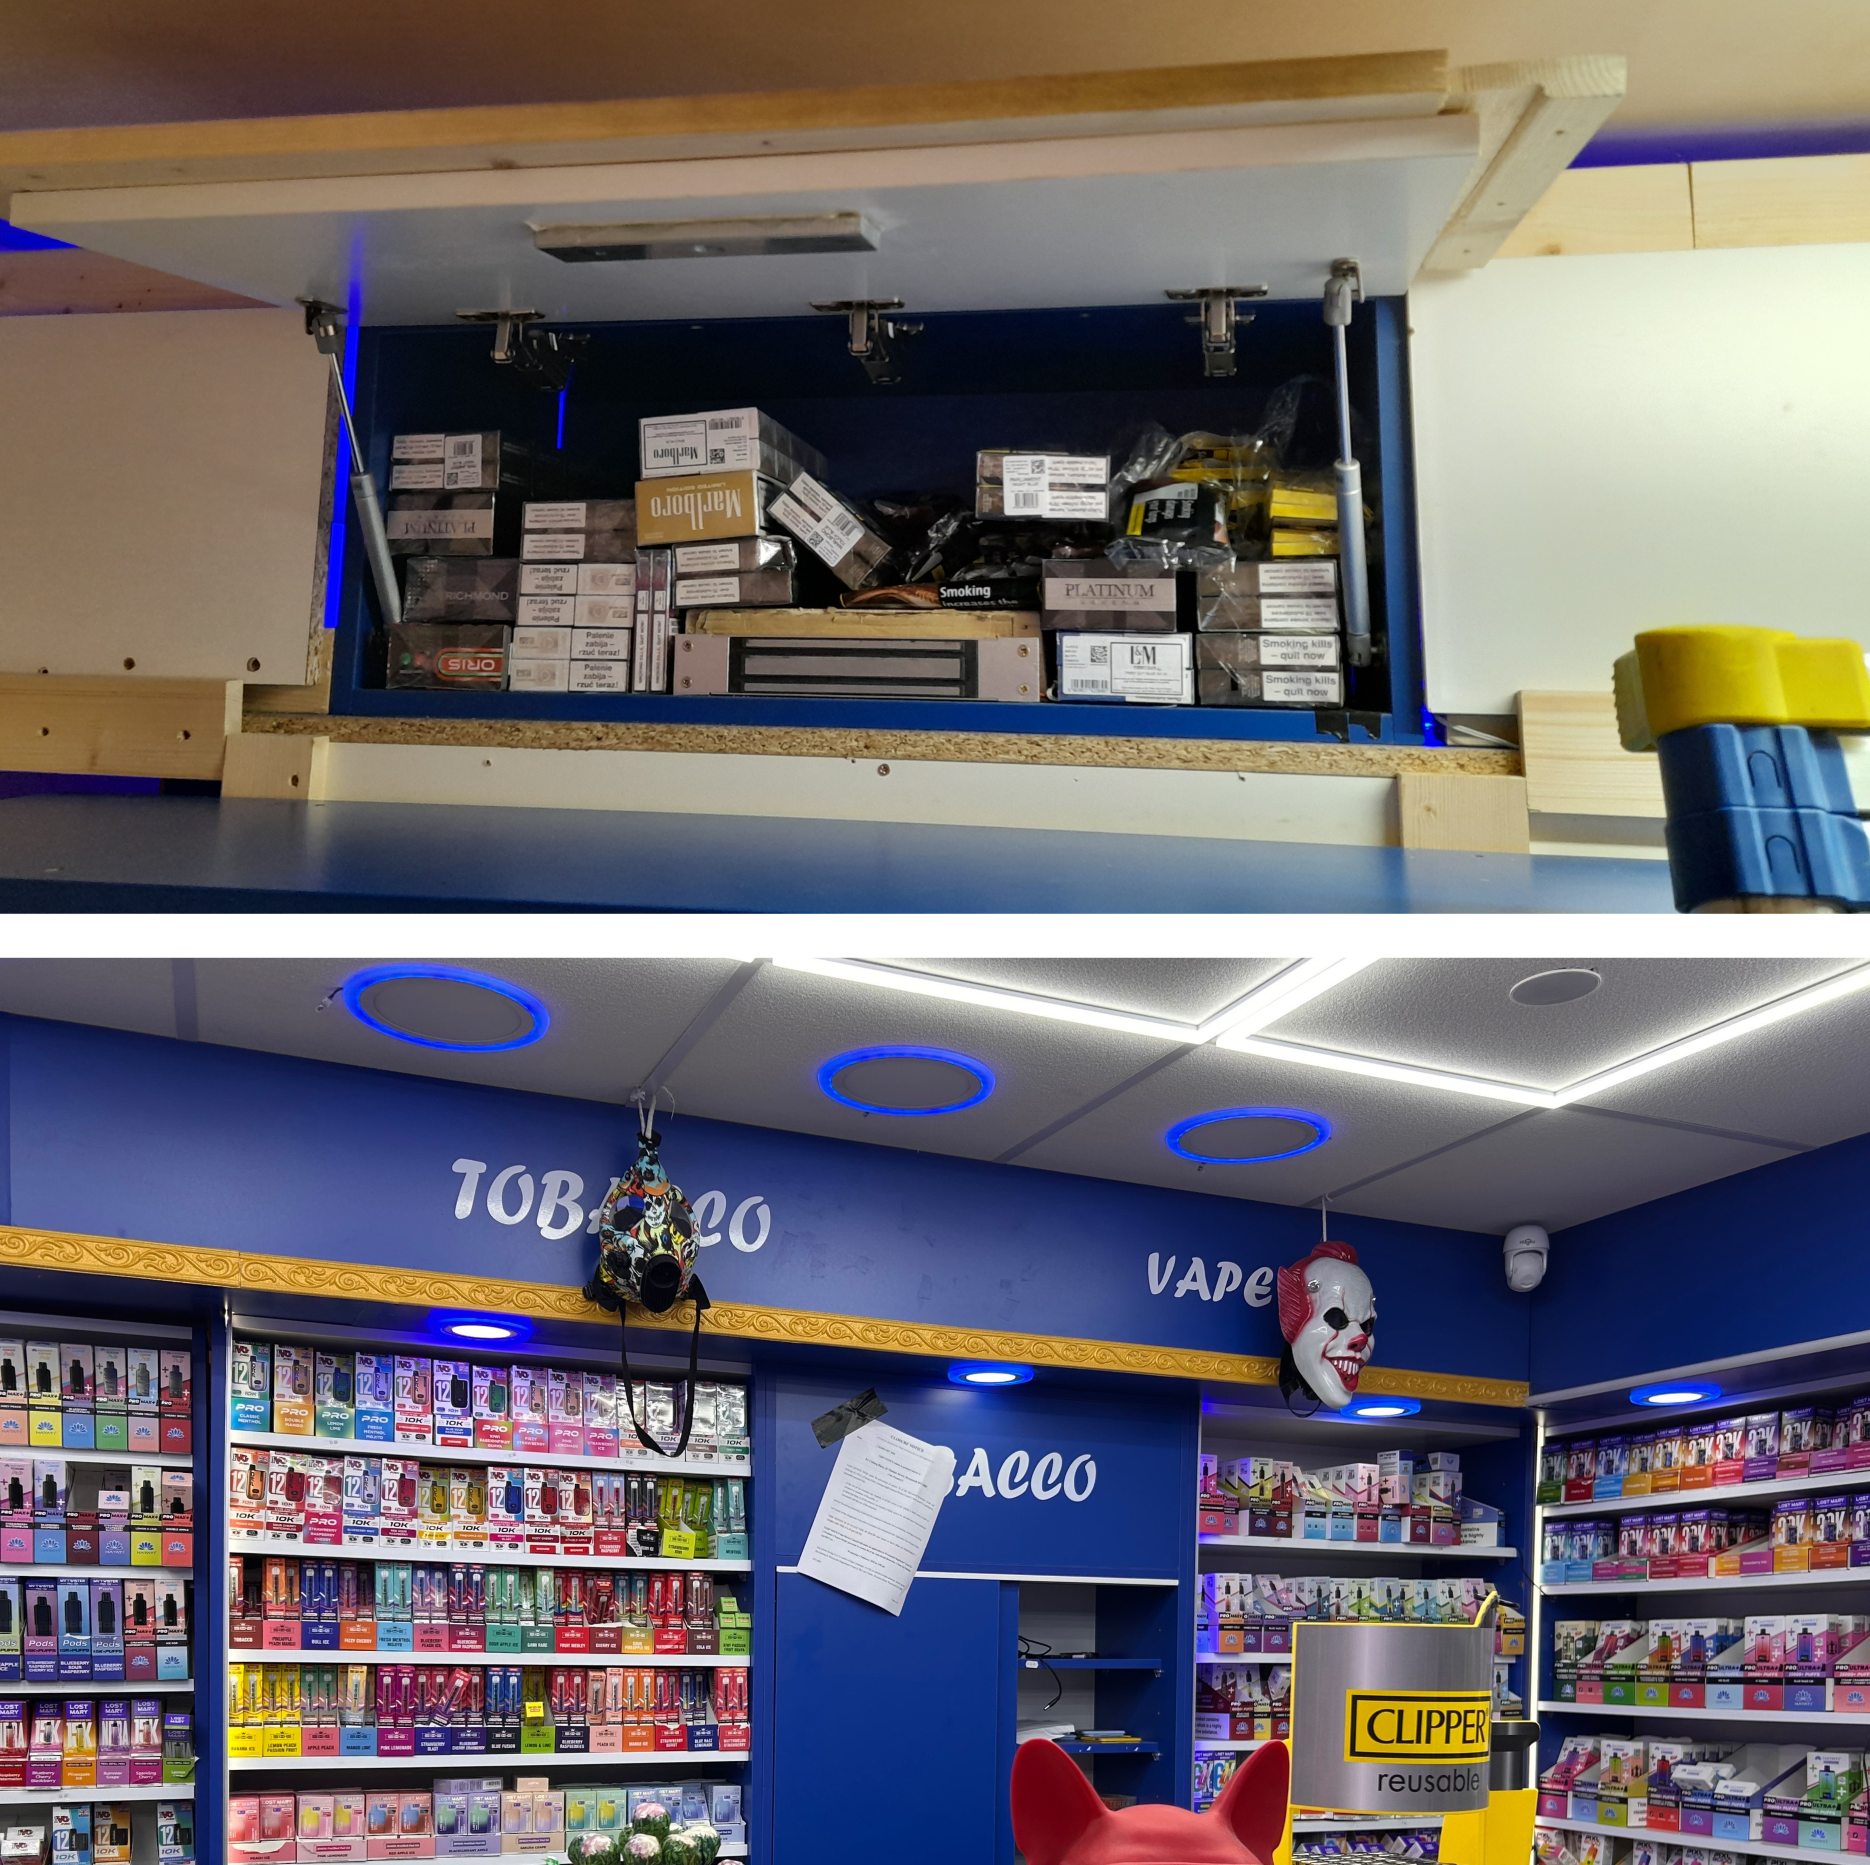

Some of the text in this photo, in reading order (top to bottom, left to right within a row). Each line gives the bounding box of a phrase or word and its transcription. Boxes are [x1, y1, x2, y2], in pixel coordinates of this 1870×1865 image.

[654, 447, 698, 465] Marlboro
[666, 482, 726, 492] LIMITED EDITION
[650, 488, 742, 530] Marlboro
[404, 522, 476, 534] PLATINUM
[940, 585, 991, 598] Smoking
[1065, 584, 1154, 597] PLATINUM
[586, 631, 614, 640] Palenie
[585, 640, 608, 649] zabija
[1263, 639, 1332, 650] Smoking kills
[579, 648, 620, 657] rzuć teraz!
[1280, 651, 1301, 661] quit
[448, 659, 495, 671] ORIS
[584, 664, 612, 672] Palenie
[583, 672, 606, 681] zabija
[1266, 675, 1336, 686] Smoking kills
[577, 680, 619, 689] rzuć teraz!
[1284, 687, 1304, 697] quit
[452, 1158, 772, 1252] TOBCO
[1148, 1252, 1274, 1308] VAPE
[890, 1435, 924, 1452] CLOSURE NOTICE
[1366, 1708, 1486, 1745] CLIPPER
[1378, 1768, 1480, 1793] reusable
[55, 1830, 69, 1850] 12
[96, 1826, 110, 1844] 12
[161, 1826, 174, 1844] 12
